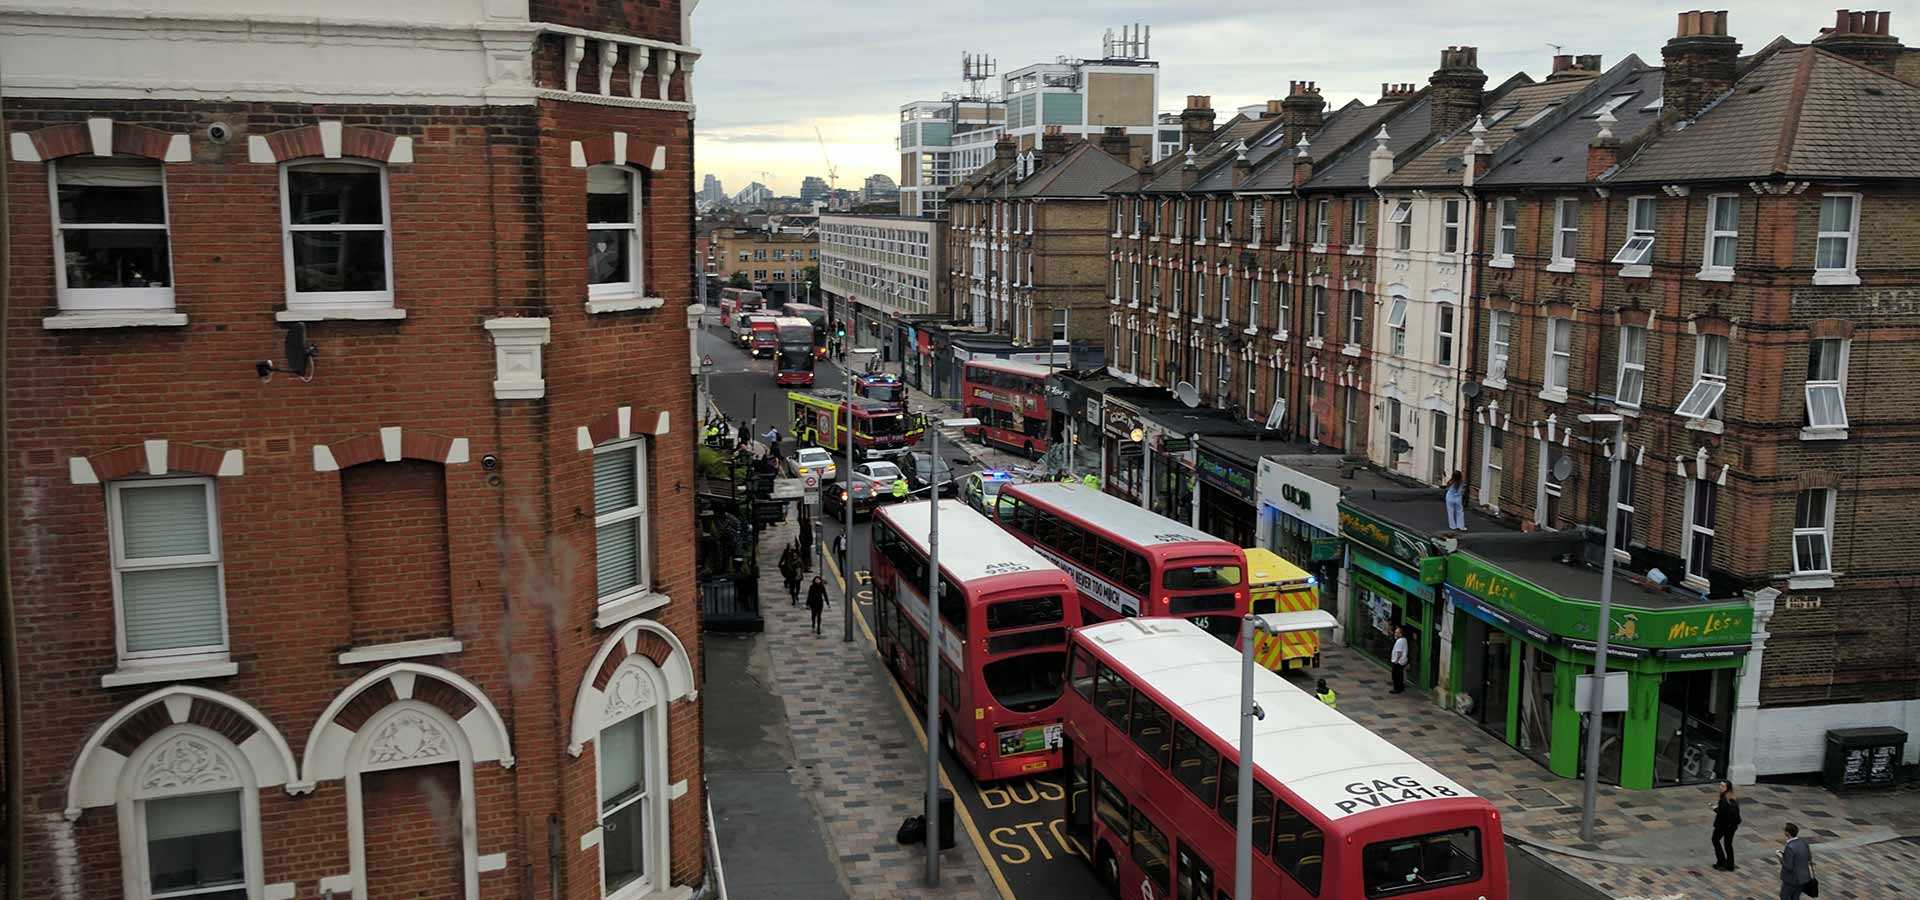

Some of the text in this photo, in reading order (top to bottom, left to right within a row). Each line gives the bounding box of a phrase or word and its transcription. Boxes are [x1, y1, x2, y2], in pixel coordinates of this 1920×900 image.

[1075, 570, 1092, 591] NEVER
[1092, 579, 1104, 597] TOO
[1103, 586, 1120, 606] MUCH
[979, 779, 1066, 809] BUS
[1335, 785, 1459, 814] PVL418
[1345, 776, 1421, 795] GAG
